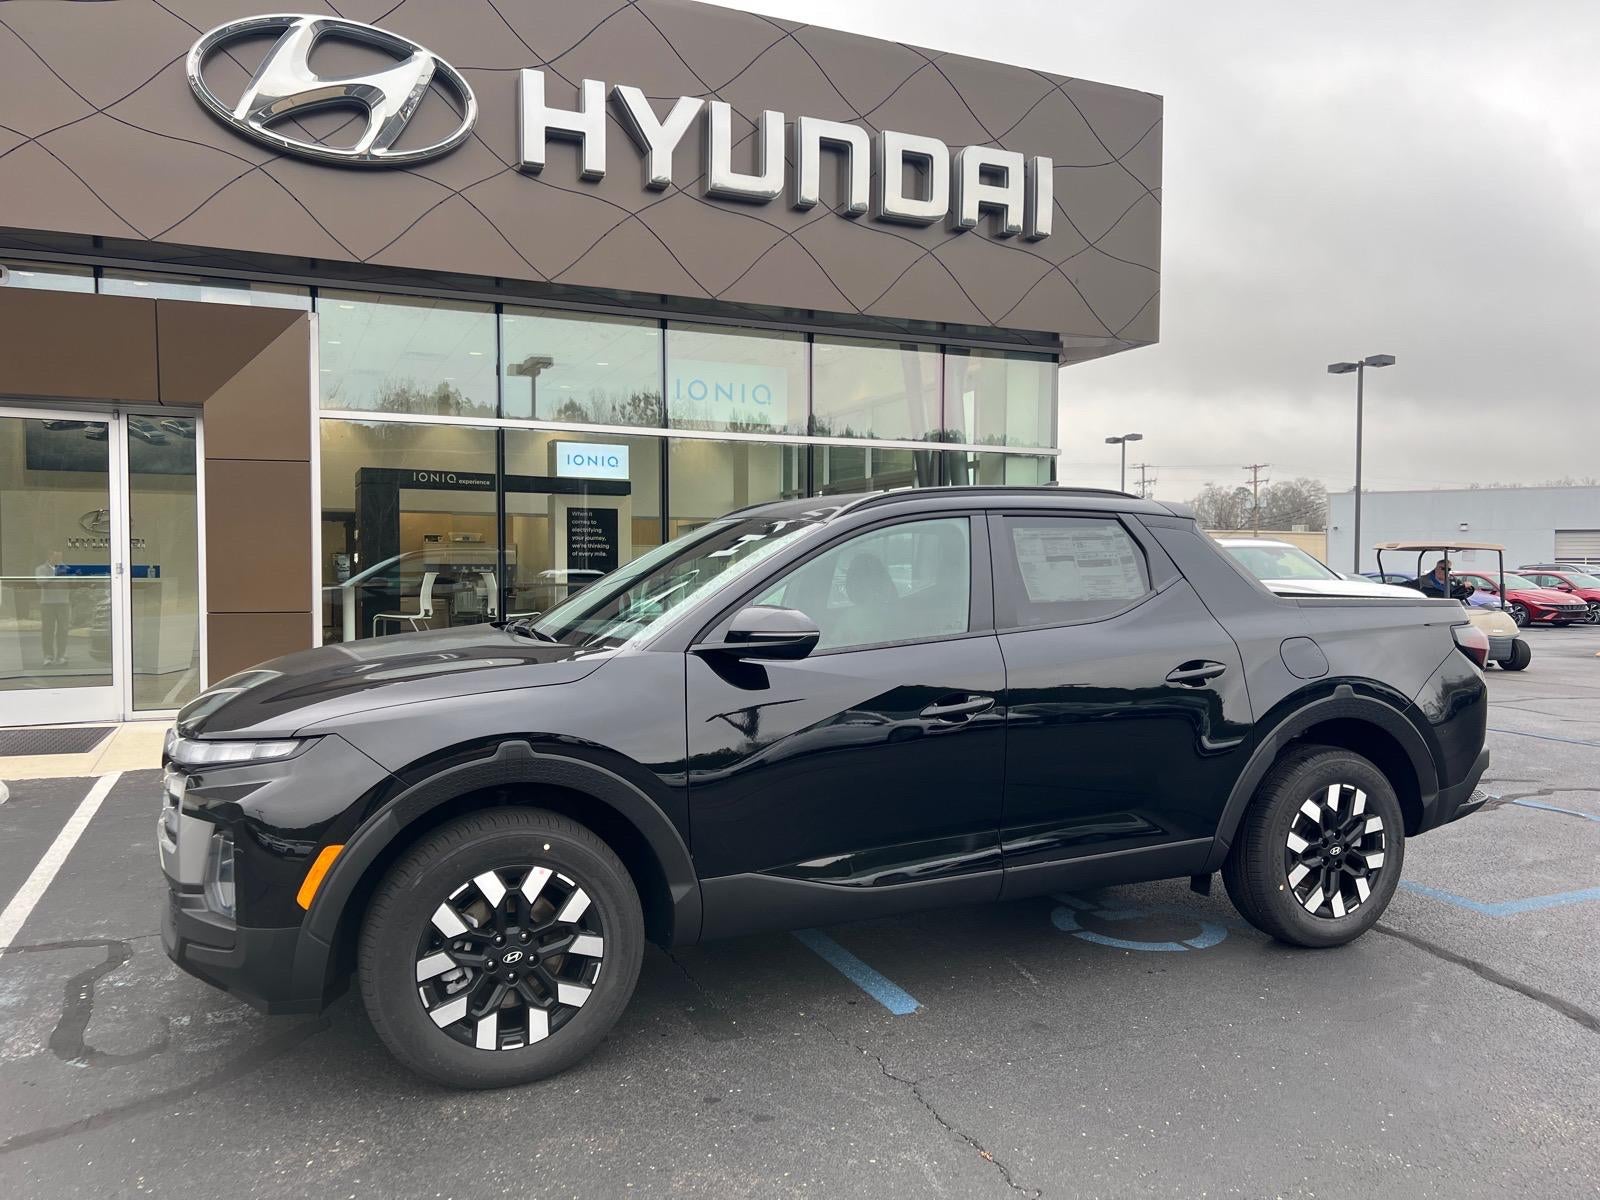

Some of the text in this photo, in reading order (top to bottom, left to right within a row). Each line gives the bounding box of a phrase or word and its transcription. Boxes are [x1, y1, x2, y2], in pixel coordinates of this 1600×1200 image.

[518, 68, 1054, 241] HYUNDAI
[675, 378, 772, 405] IONIQ
[567, 454, 619, 467] IONIQ
[413, 471, 457, 484] IONIQ
